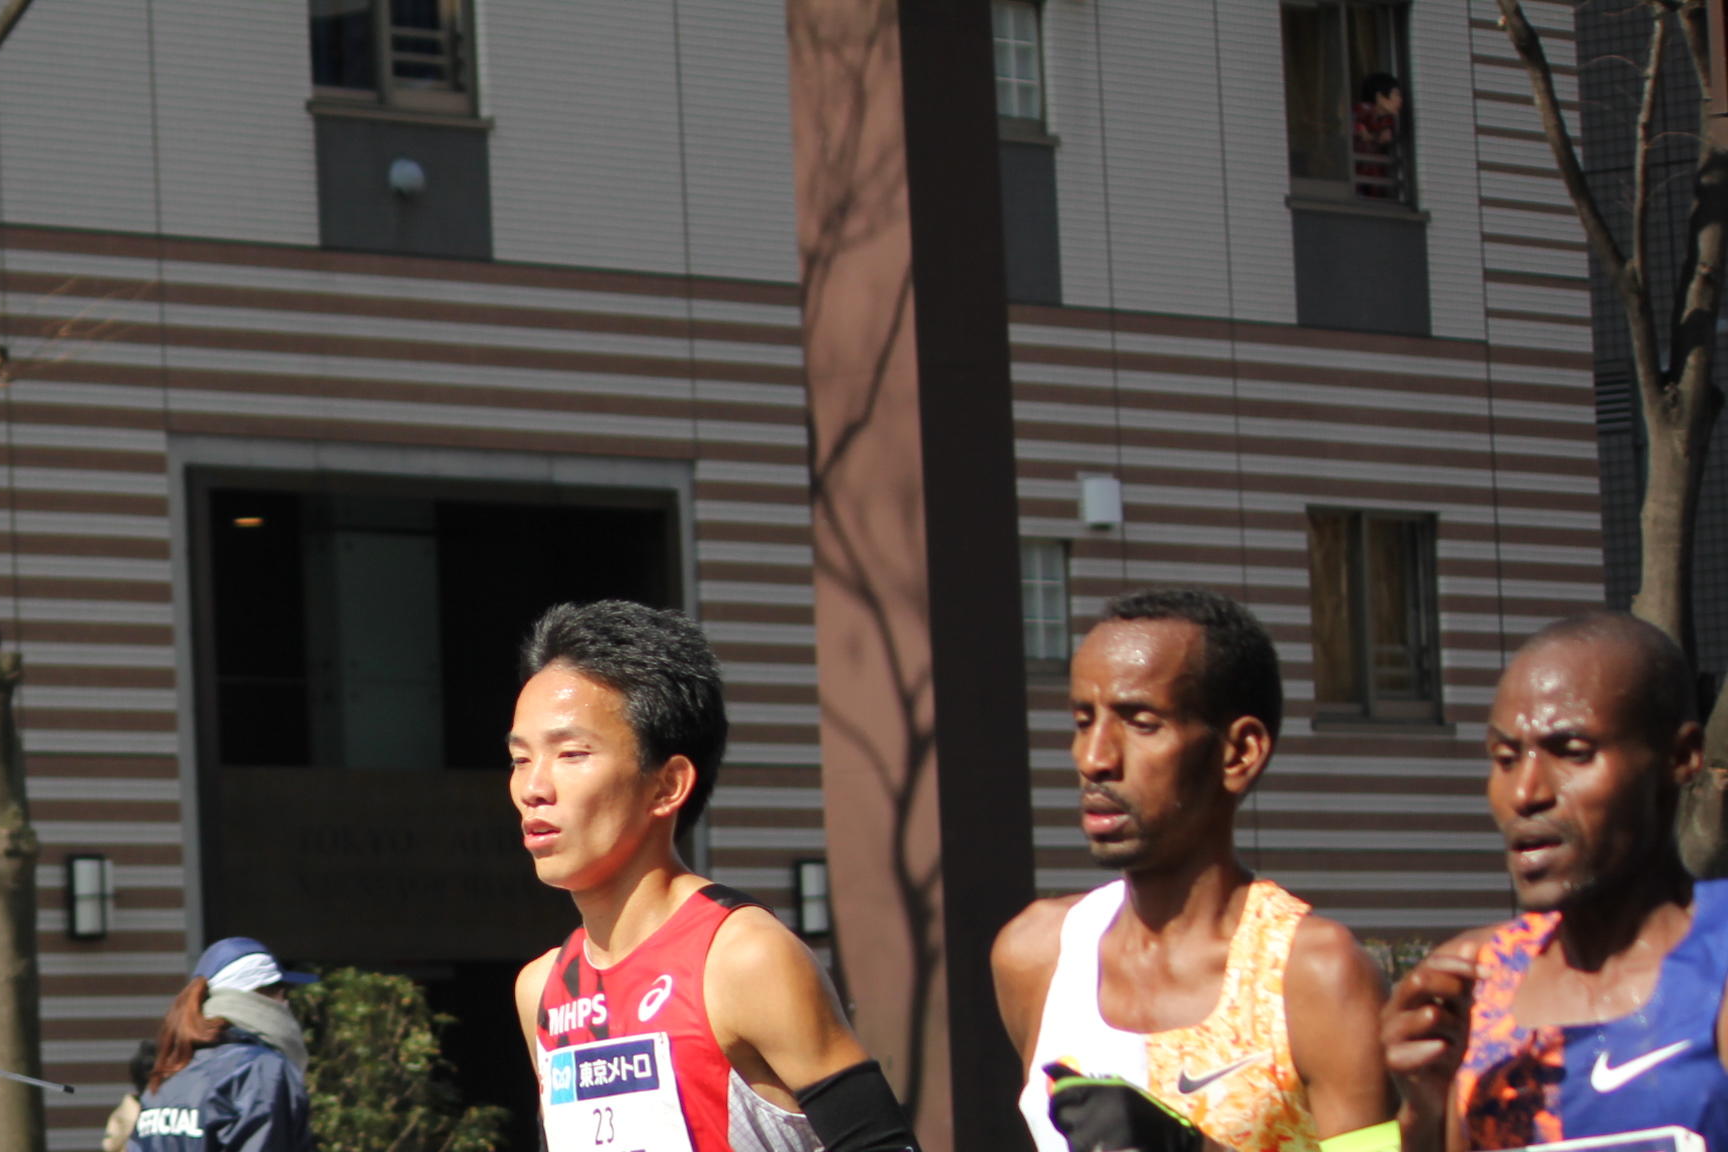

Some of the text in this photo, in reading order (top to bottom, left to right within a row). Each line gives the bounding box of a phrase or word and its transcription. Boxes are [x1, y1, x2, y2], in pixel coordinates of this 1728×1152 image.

[547, 993, 608, 1037] MHPS
[579, 1051, 653, 1089] 東京メトロ
[592, 1105, 616, 1146] 23
